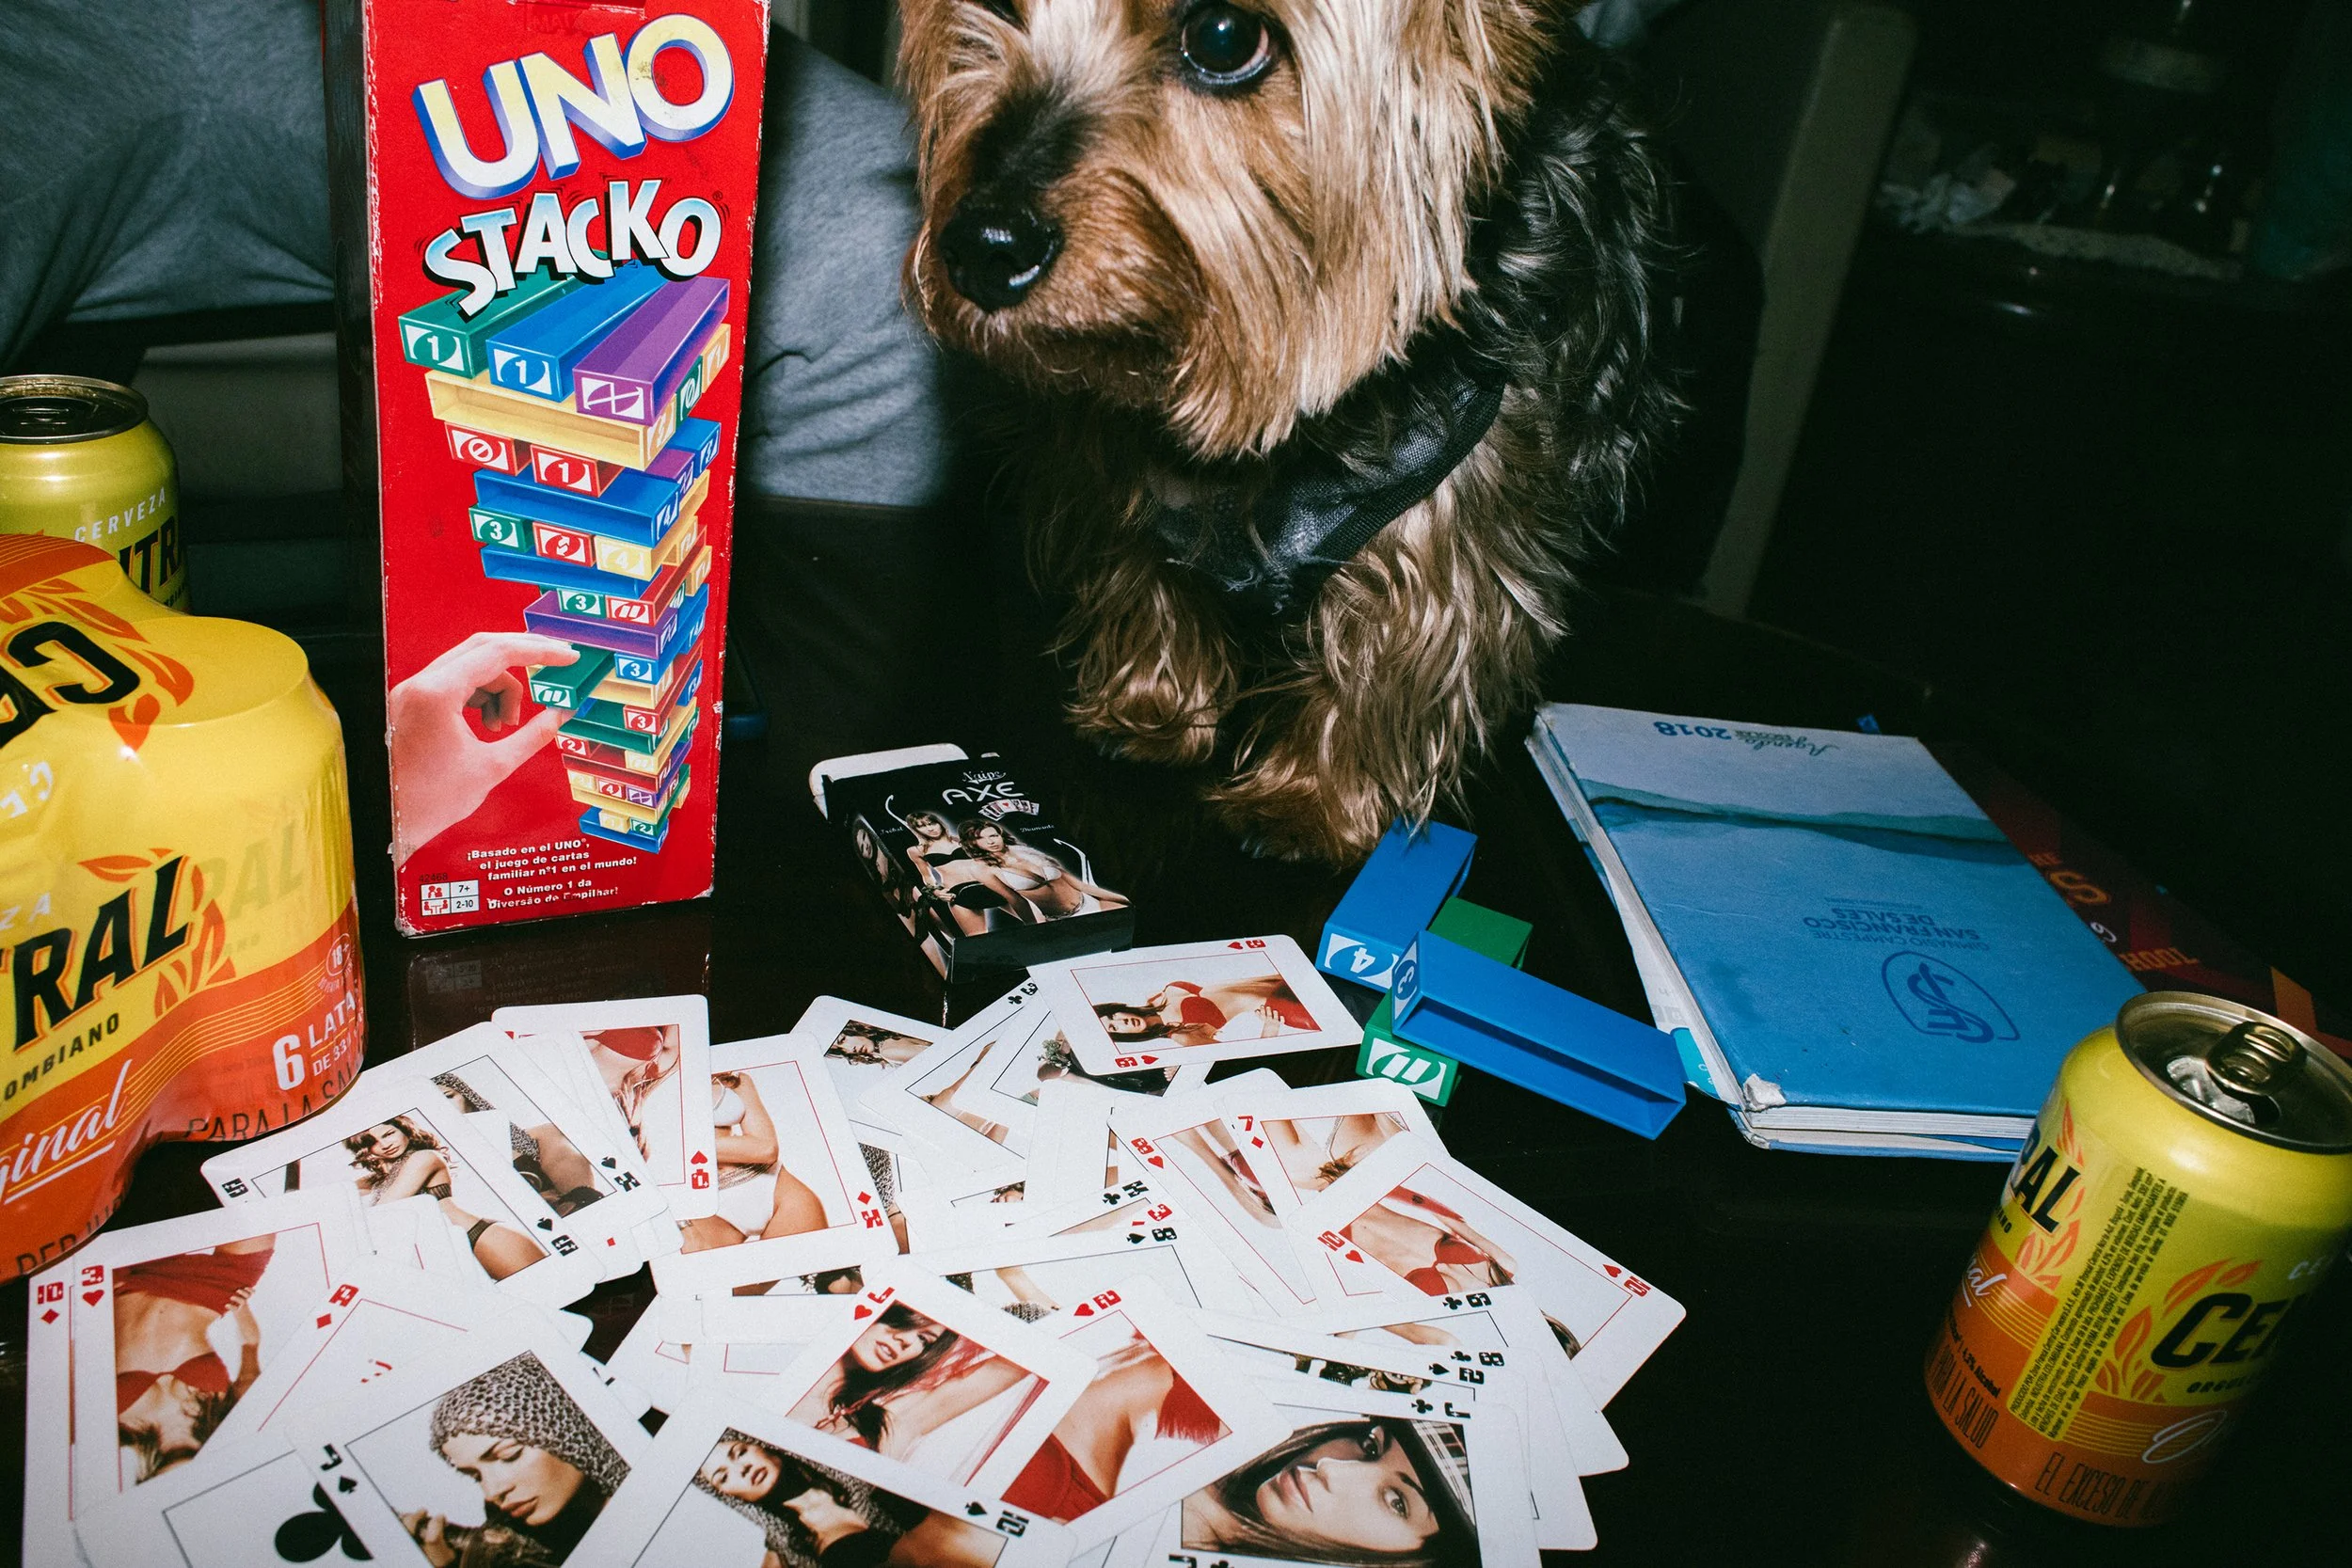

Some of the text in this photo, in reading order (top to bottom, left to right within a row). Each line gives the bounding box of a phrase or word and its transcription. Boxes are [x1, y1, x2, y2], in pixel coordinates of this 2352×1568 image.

[411, 13, 735, 200] UNO
[421, 180, 724, 319] STACKO
[74, 486, 167, 543] CERVEZA
[1653, 721, 1732, 740] 2018
[942, 782, 1025, 805] AXE
[467, 847, 517, 861] ¡Basado
[520, 846, 536, 854] en
[539, 843, 551, 853] el
[480, 851, 590, 871] el juego de cartas
[419, 872, 448, 883] 42468
[487, 868, 535, 881] familiar
[562, 864, 577, 873] en
[580, 861, 592, 870] el
[595, 856, 637, 868] mundo!
[458, 884, 470, 893] 7+
[503, 879, 593, 895] O Número 1 da
[455, 899, 474, 909] 2-10
[1831, 908, 1900, 923] SALES
[1803, 916, 1979, 941] SAN FRANCISCO
[1352, 946, 1376, 974] 4
[272, 1033, 306, 1091] 6
[312, 1053, 332, 1077] DE
[1237, 1115, 1255, 1132] 7
[1130, 1136, 1155, 1155] 8
[612, 1170, 642, 1194] K
[1121, 1180, 1150, 1199] K
[860, 1208, 884, 1229] K
[1146, 1203, 1173, 1222] 3
[1151, 1227, 1178, 1243] 8
[1317, 1229, 1345, 1252] 10
[81, 1264, 105, 1288] 3
[1623, 1275, 1652, 1298] 10
[38, 1281, 65, 1305] 10
[328, 1283, 359, 1308] A
[866, 1286, 897, 1306] J
[1092, 1289, 1122, 1310] 2
[1479, 1352, 1505, 1368] 8
[1973, 1365, 2001, 1399] Alcohol
[2009, 1384, 2029, 1413] PRODUCIDO
[2023, 1373, 2035, 1386] POR
[2034, 1348, 2048, 1365] Franca
[2042, 1332, 2057, 1350] Central
[1444, 1402, 1470, 1419] J
[1954, 1385, 1999, 1449] SALUD
[319, 1443, 343, 1472] J
[2035, 1451, 2065, 1496] EL
[2058, 1463, 2126, 1515] EXCESO
[995, 1510, 1029, 1539] 10
